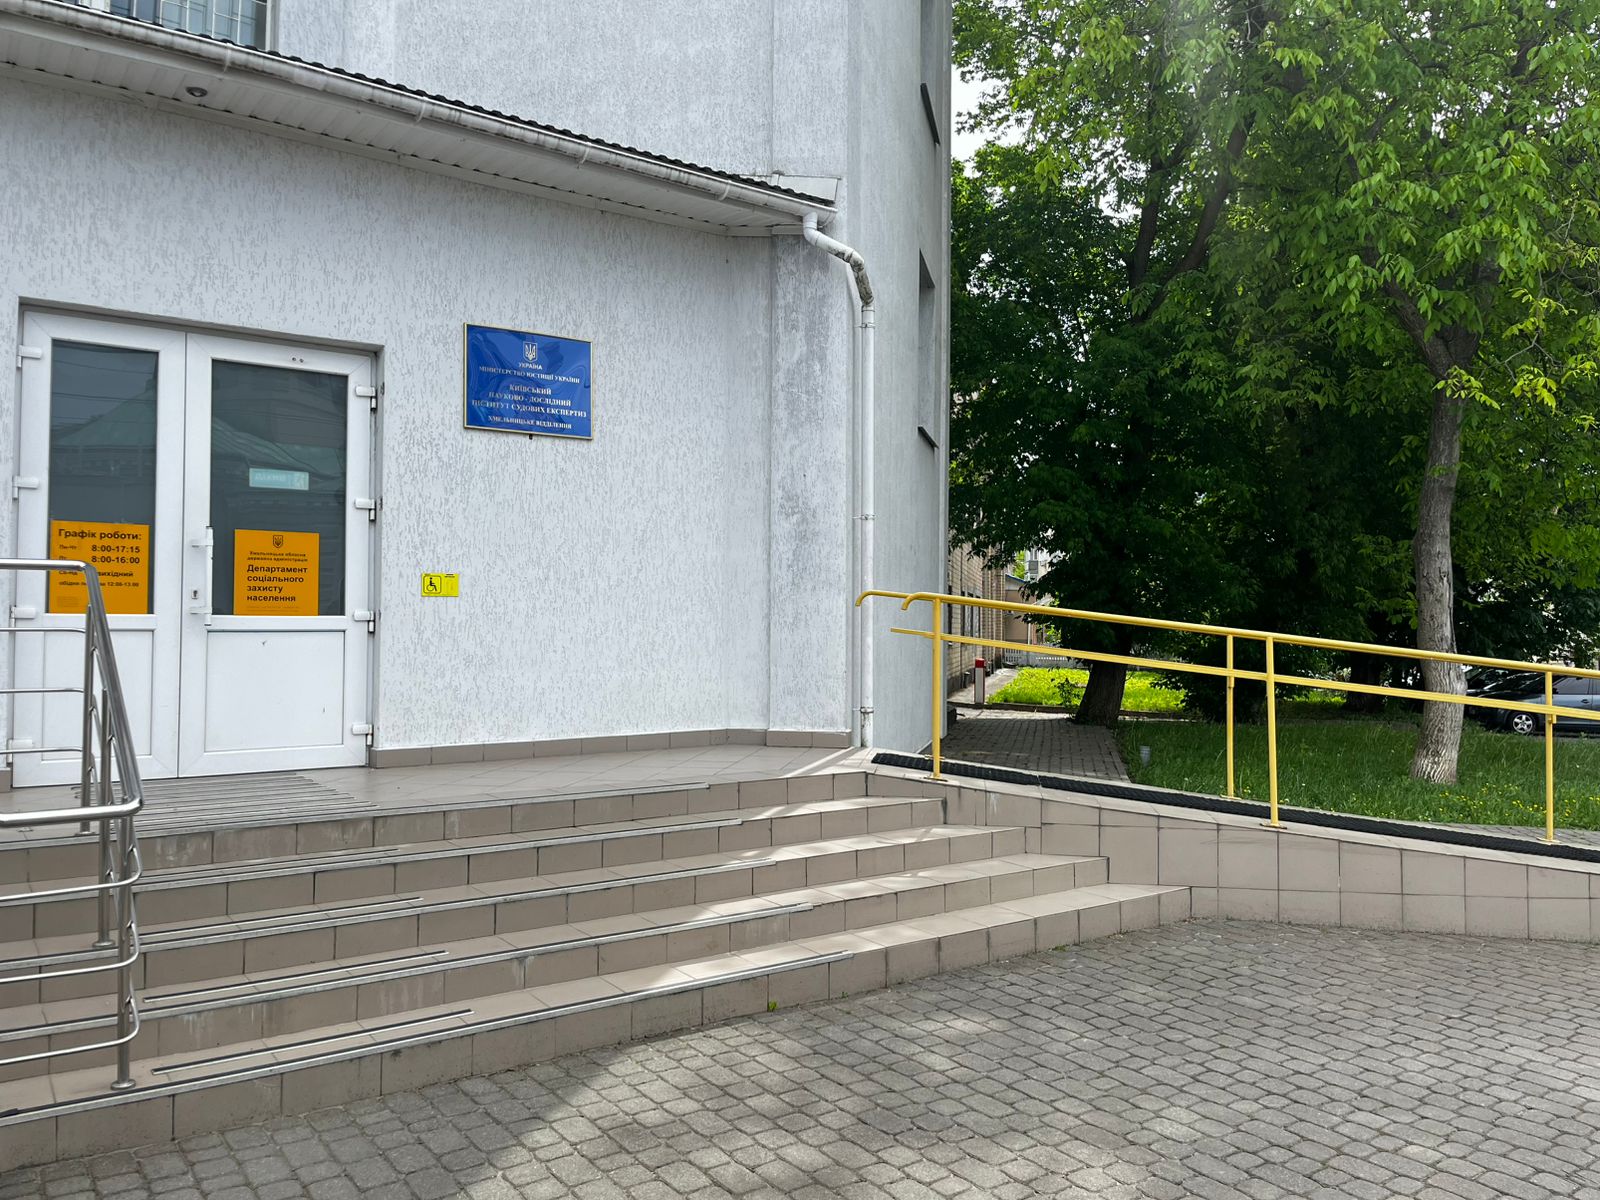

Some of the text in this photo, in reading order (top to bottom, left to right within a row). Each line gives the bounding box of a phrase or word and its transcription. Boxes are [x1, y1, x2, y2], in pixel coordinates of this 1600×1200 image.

[519, 362, 542, 370] УКРАЇНА
[479, 366, 580, 384] МІНІСТЕРСТВО ЮСТИЦІЇ УКРАЇНИ
[509, 384, 552, 395] КИЇВСЬКИЙ
[488, 392, 524, 401] НАУКОВО
[529, 396, 572, 407] ДОСЛІДНИЙ
[472, 400, 587, 418] ІНСТИТУТ СУДОВИХ ЕКСПЕРТИЗ
[536, 420, 572, 430] ВІДДІЛЕННЯ
[58, 528, 142, 540] Графік роботи:
[91, 544, 140, 553] 8:00-17:15
[91, 555, 140, 564] 8:00-16:00
[247, 564, 308, 573] Департамент
[247, 575, 304, 583] соціального
[247, 585, 283, 593] захисту
